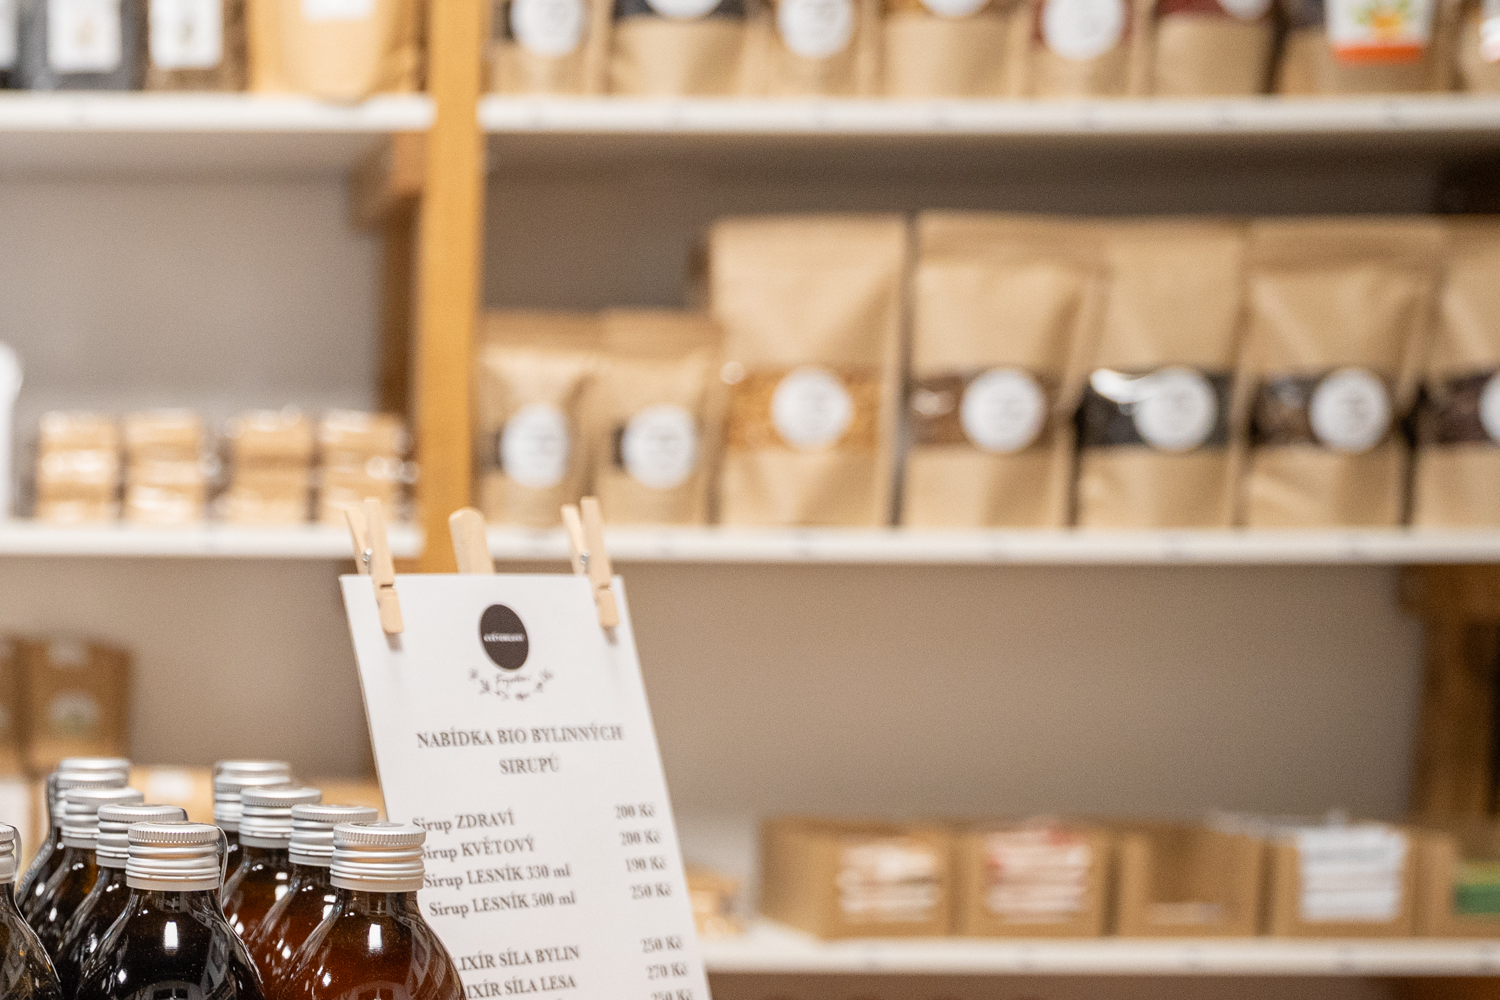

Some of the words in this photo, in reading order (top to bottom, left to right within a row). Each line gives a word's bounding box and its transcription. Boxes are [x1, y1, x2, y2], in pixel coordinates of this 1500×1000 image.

[416, 727, 493, 748] NABÍDKA
[496, 729, 526, 744] BIO
[531, 720, 623, 743] BYLINNÝCH
[412, 817, 452, 833] Sirup
[455, 808, 515, 829] ZDRAVÍ
[614, 804, 636, 819] 200
[461, 834, 535, 858] KVĚTOVÝ
[619, 831, 641, 846] 200
[625, 858, 646, 872] 190
[424, 874, 463, 889] Sirup
[466, 865, 523, 885] LESNÍK
[526, 865, 550, 879] 330
[553, 864, 570, 878] ml
[630, 885, 651, 899] 250
[429, 902, 468, 918] Sirup
[471, 892, 529, 913] LESNÍK
[532, 892, 555, 907] 500
[558, 891, 576, 905] ml
[640, 938, 662, 953] 250
[500, 948, 531, 966] SÍLA
[536, 945, 579, 963] BYLIN
[646, 964, 668, 980] 270
[505, 976, 537, 994] SÍLA
[541, 975, 576, 991] LESA
